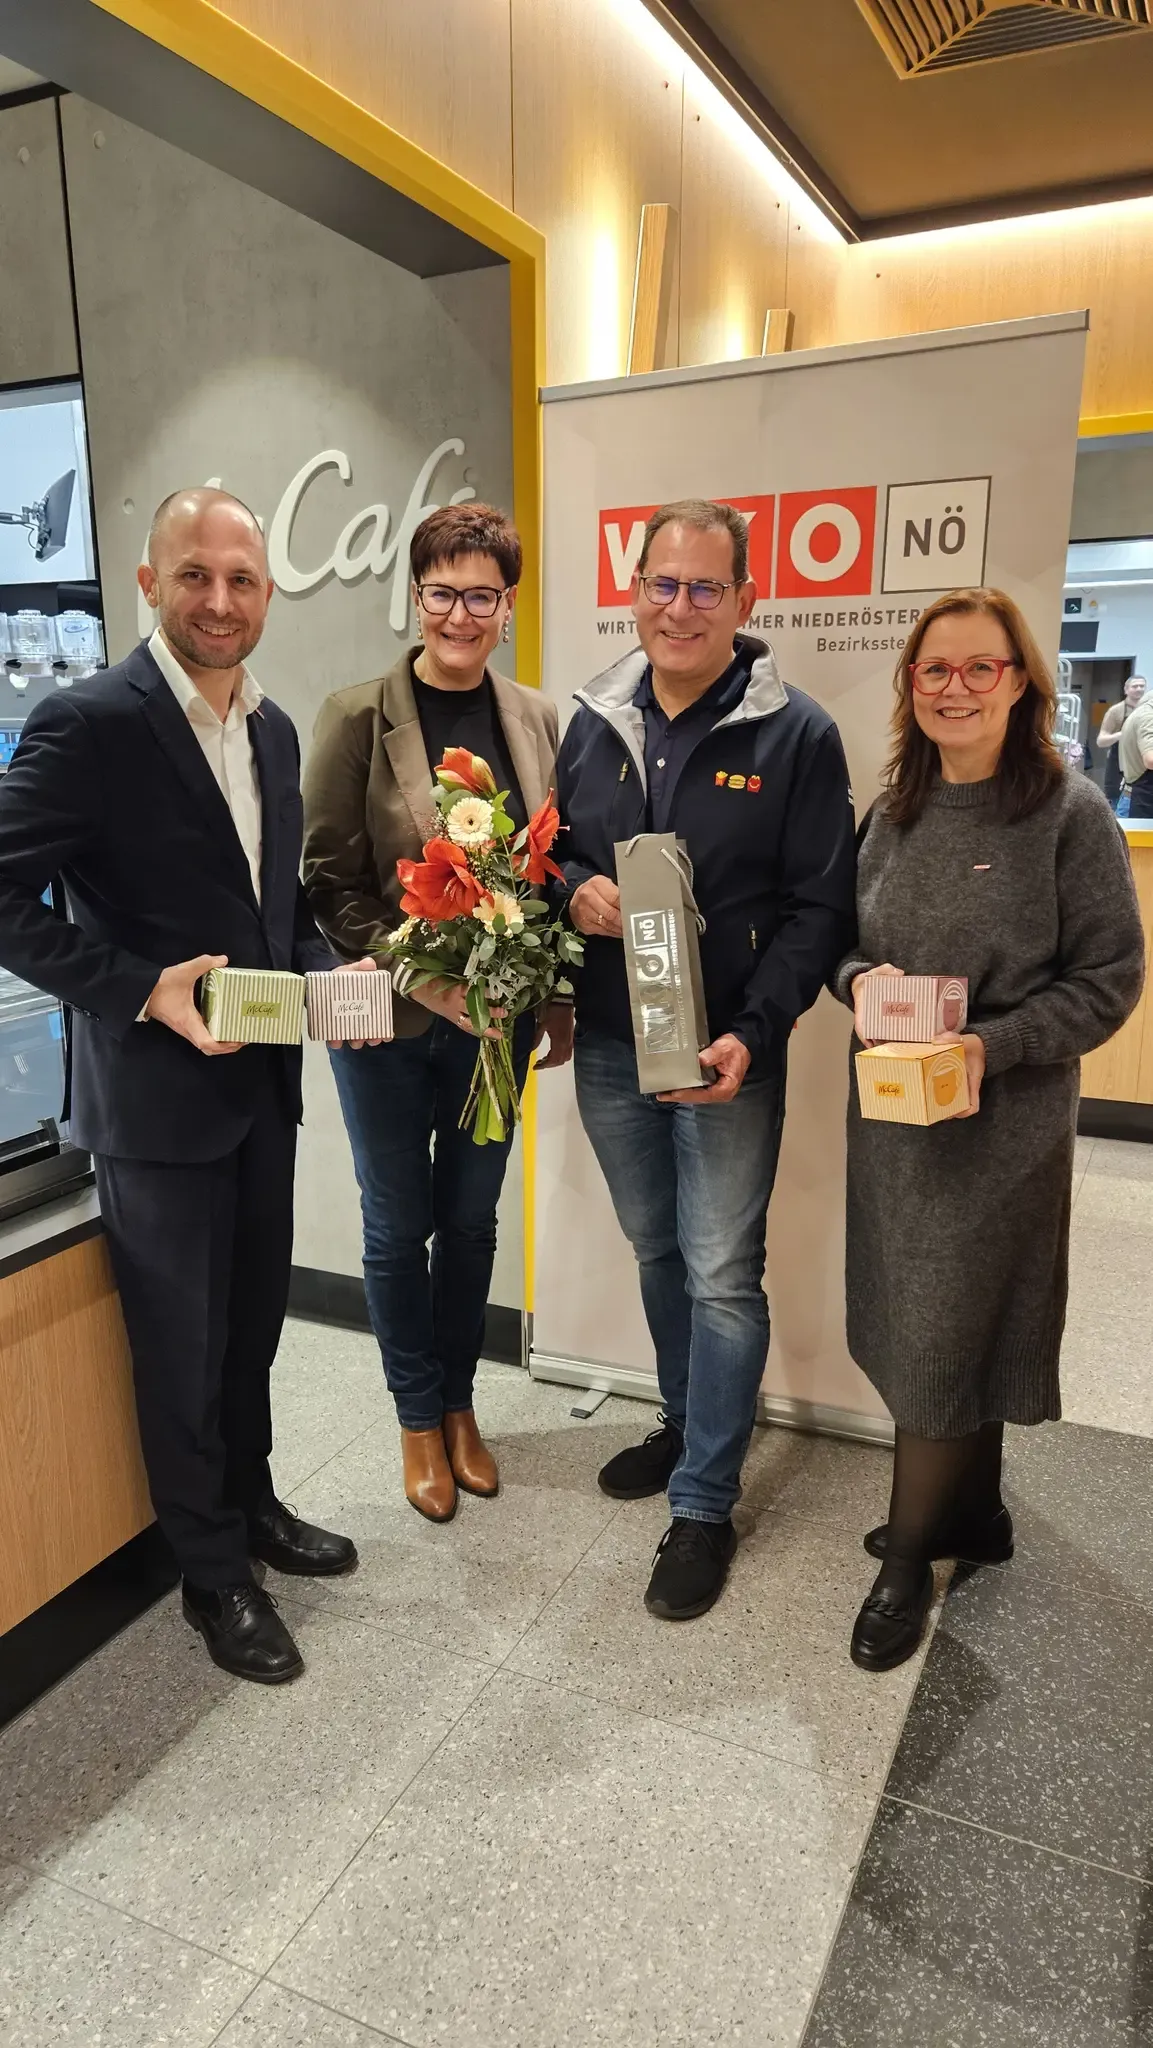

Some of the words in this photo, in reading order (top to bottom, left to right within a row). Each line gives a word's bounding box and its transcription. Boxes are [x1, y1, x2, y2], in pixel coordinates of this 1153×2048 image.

[903, 505, 966, 558] NÖ
[791, 606, 928, 629] NIEDERÖSTER
[817, 634, 910, 652] Bezirksste
[639, 918, 657, 941] NÖ
